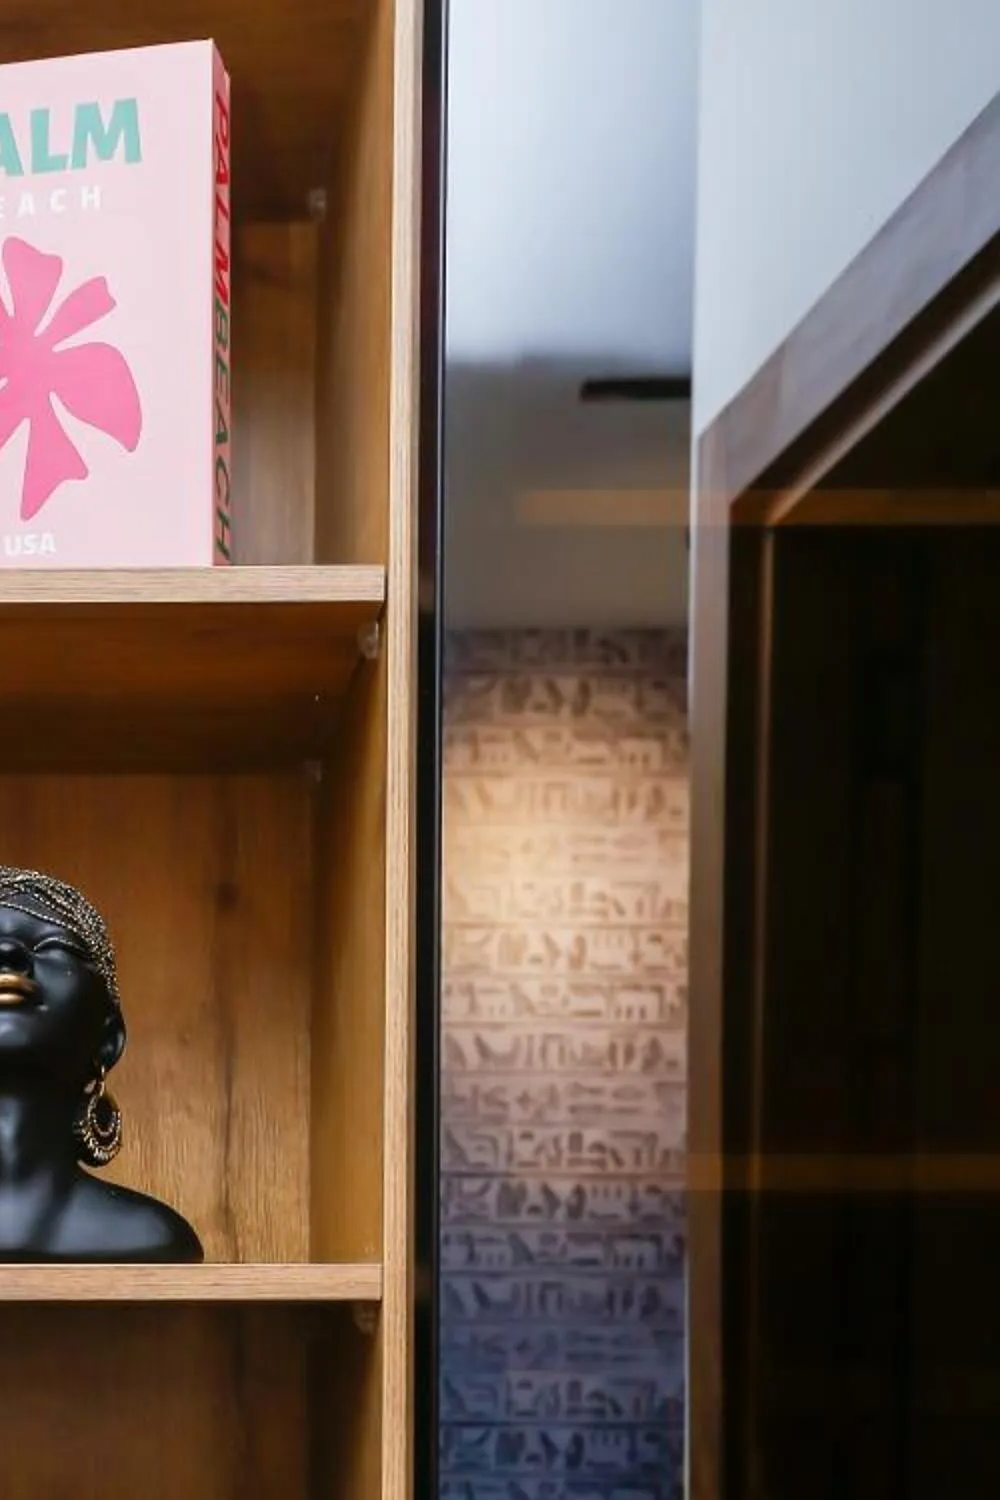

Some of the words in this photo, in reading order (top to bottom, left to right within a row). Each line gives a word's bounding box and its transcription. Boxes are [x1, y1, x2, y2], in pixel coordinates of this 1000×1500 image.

[216, 92, 229, 305] PALM
[215, 299, 230, 560] BEACH
[4, 532, 56, 556] USA
